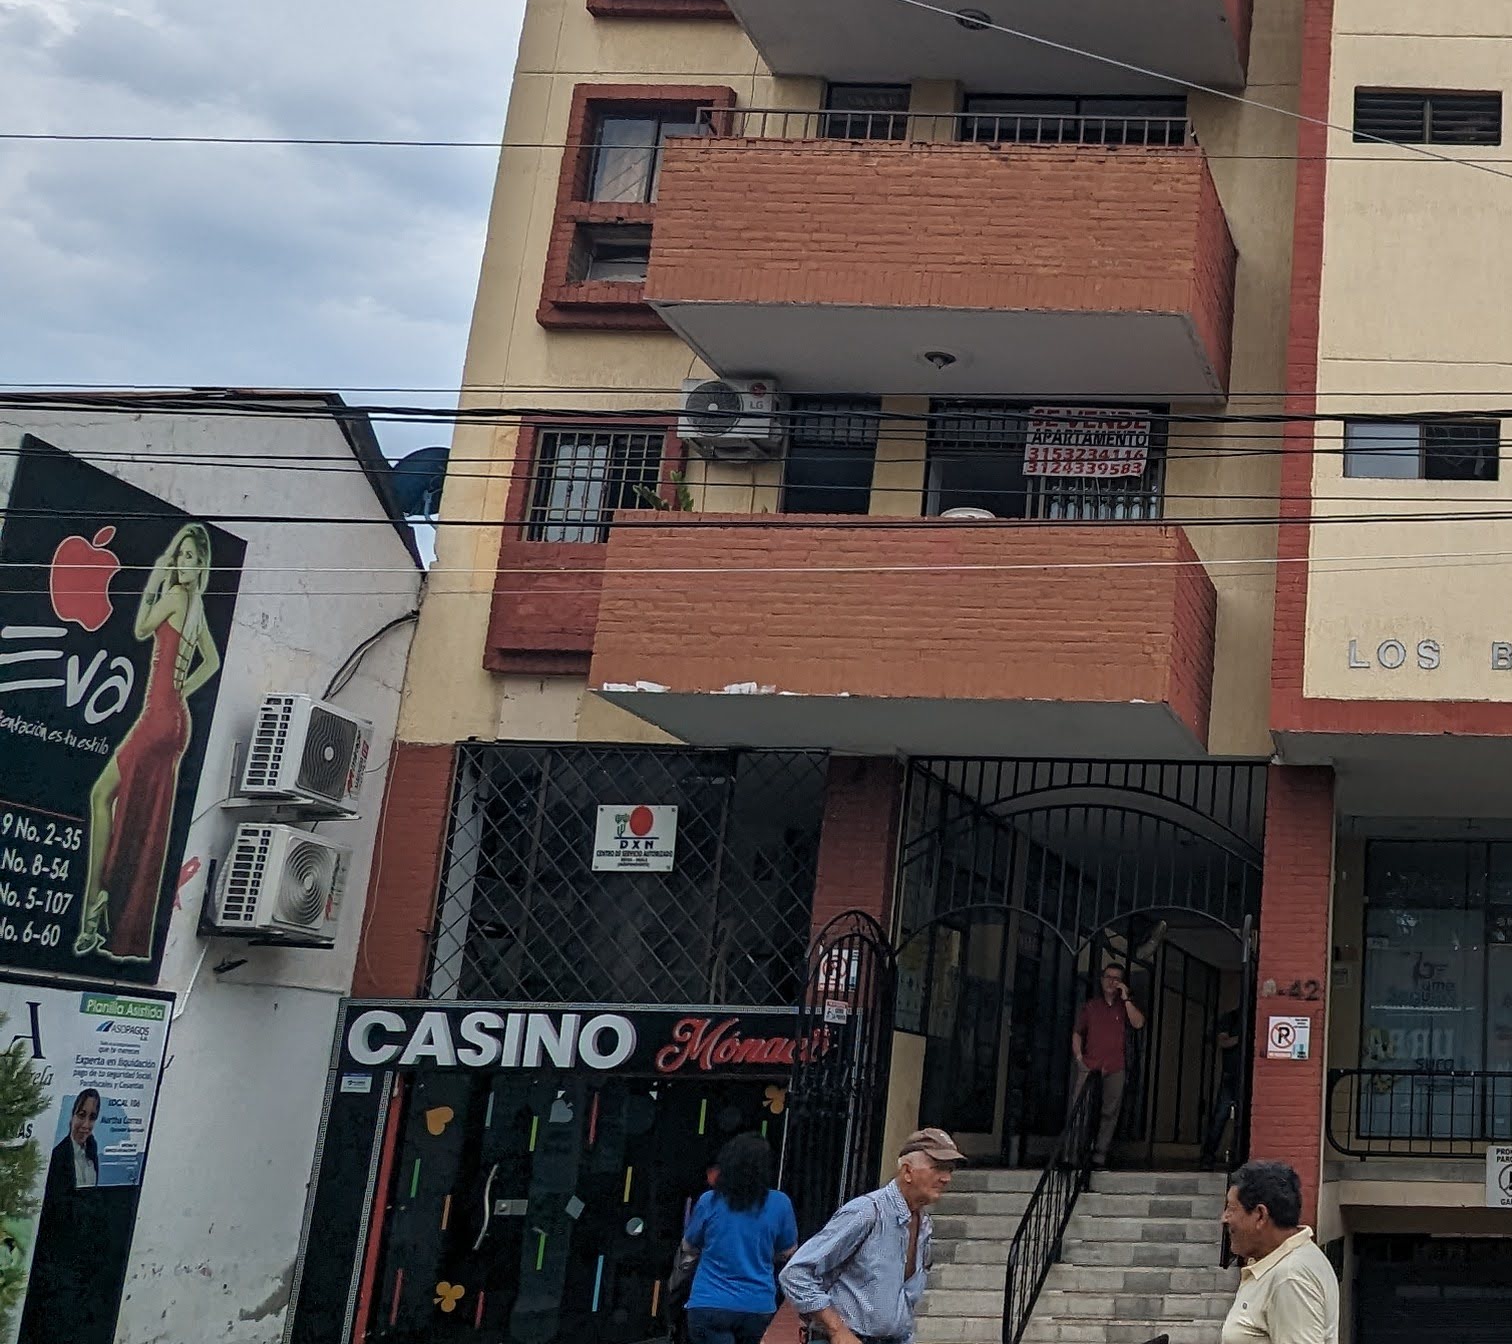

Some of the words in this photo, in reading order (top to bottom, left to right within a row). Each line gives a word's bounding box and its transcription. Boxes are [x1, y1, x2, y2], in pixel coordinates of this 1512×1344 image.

[750, 401, 764, 410] LG
[1064, 409, 1148, 430] VENDE
[1031, 429, 1147, 447] APARTAMENTO
[1026, 460, 1142, 475] 3124339583
[1347, 638, 1441, 670] LOS
[14, 815, 41, 843] No.
[43, 822, 83, 851] 2-35
[0, 847, 28, 874] No.
[31, 853, 70, 881] 8-54
[25, 886, 75, 915] 5-107
[22, 920, 61, 947] 6-60
[87, 998, 124, 1015] Planilla
[347, 1009, 637, 1070] CASINO
